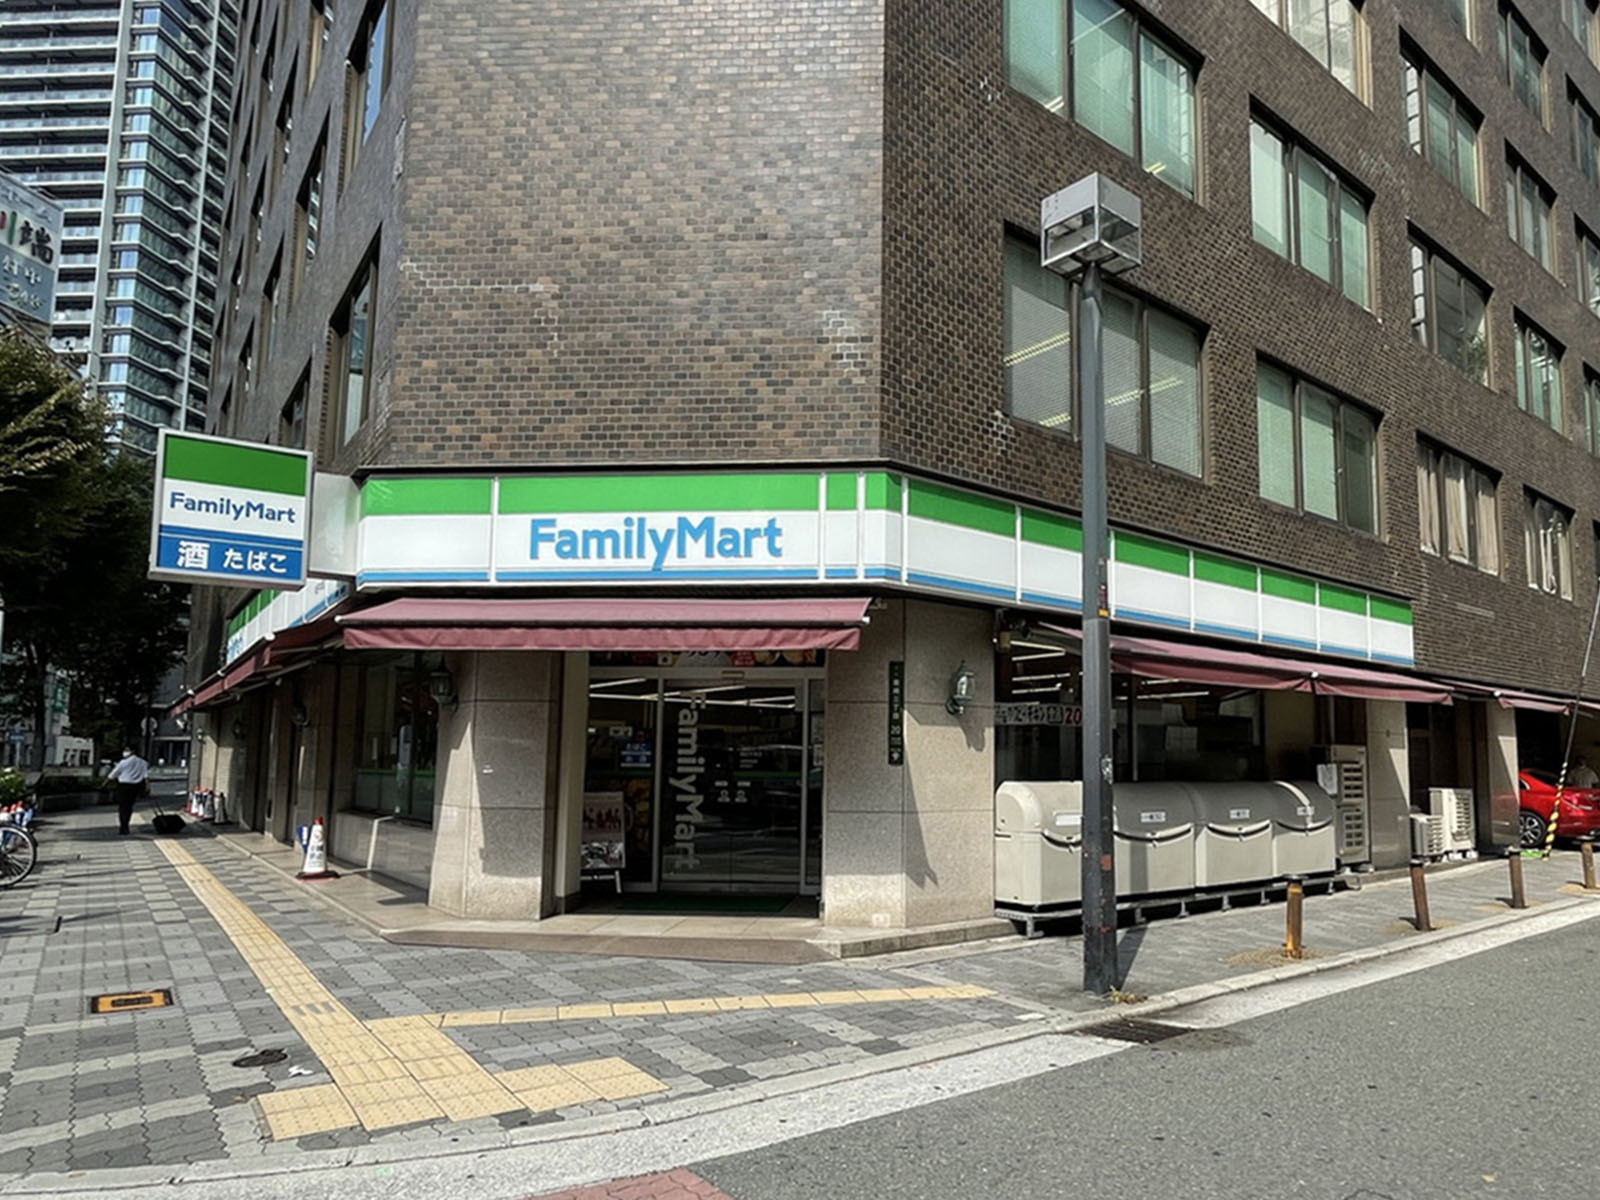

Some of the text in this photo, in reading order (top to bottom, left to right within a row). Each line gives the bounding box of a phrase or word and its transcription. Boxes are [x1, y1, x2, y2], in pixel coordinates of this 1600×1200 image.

[170, 492, 296, 523] FamilyMart
[177, 541, 288, 574] 酒 たばこ
[529, 516, 783, 571] FamilyMart
[669, 691, 707, 870] FamilyMart
